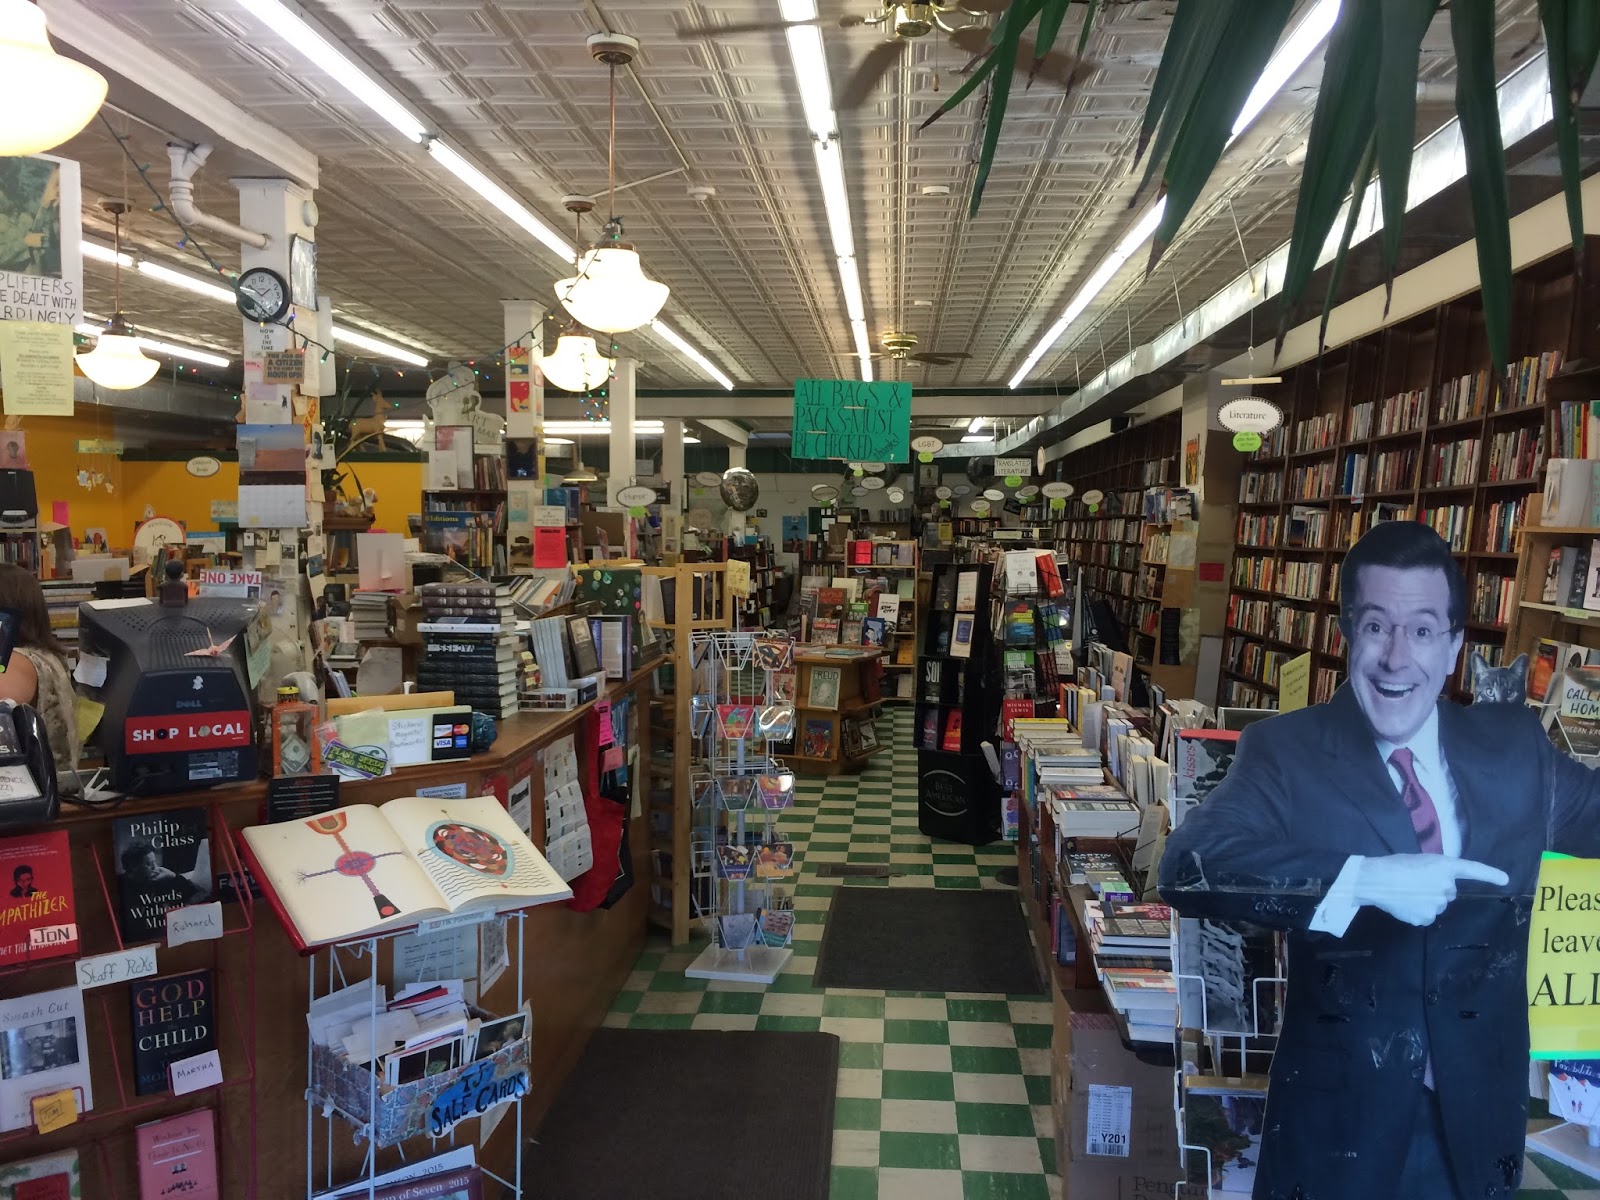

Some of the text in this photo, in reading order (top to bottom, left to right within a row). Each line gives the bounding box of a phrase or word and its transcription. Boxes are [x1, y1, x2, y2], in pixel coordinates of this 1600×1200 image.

[258, 275, 265, 283] 12
[13, 290, 49, 306] DEALT
[51, 295, 77, 309] WITH
[800, 380, 903, 408] ALL BAGS &
[1229, 410, 1267, 420] Literature
[794, 432, 809, 457] BE
[815, 433, 873, 459] CHECKED
[917, 440, 935, 448] LGBT
[995, 467, 1029, 475] LITERATURE
[200, 571, 226, 584] ONE
[230, 573, 262, 585] TAKE
[813, 670, 840, 681] FREUD
[1567, 688, 1593, 702] CALL
[176, 700, 202, 709] DELL
[133, 722, 244, 742] SHOP LOCAL
[436, 739, 451, 747] VISA
[1182, 744, 1196, 780] kisses
[130, 820, 180, 838] Philip
[151, 834, 195, 849] Glass
[31, 891, 48, 901] THE
[139, 889, 183, 905] Words
[34, 926, 70, 944] JON
[81, 962, 118, 985] Staff
[136, 980, 205, 1009] GOD
[3, 1001, 70, 1023] Smash Cut
[138, 999, 206, 1027] HELP
[138, 1025, 208, 1051] CHILD
[177, 1061, 215, 1079] MARTHA
[431, 1071, 526, 1136] SALE CARDS
[1101, 1133, 1127, 1144] Y201
[398, 1188, 411, 1200] of
[412, 1183, 443, 1198] Seven
[448, 1176, 470, 1189] 2015
